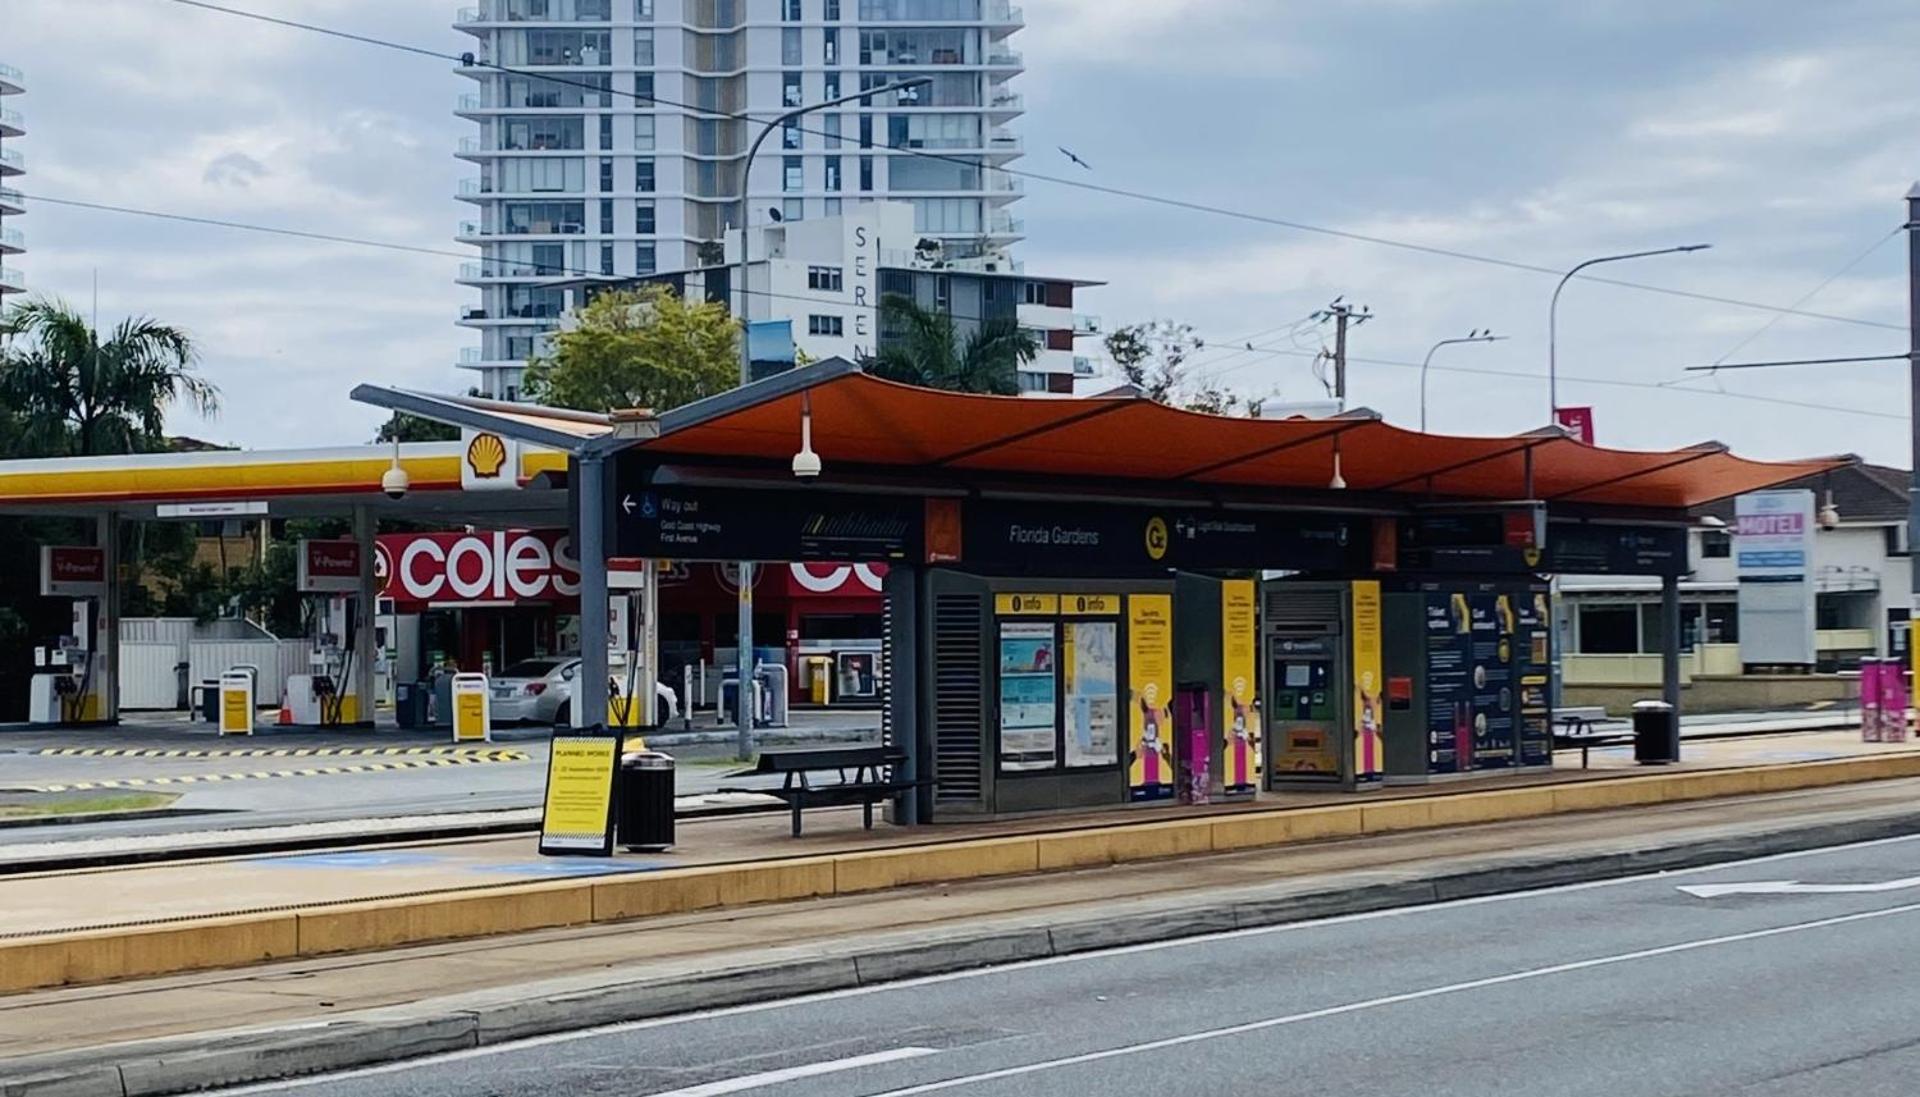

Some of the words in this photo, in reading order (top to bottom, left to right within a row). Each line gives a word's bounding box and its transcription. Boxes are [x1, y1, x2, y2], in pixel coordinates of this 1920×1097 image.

[661, 498, 681, 513] Way
[683, 500, 699, 512] out
[1738, 515, 1802, 534] MOTEL
[1009, 524, 1049, 544] Florida
[1052, 526, 1099, 546] Gardens
[1023, 596, 1041, 610] info
[1087, 597, 1104, 610] info
